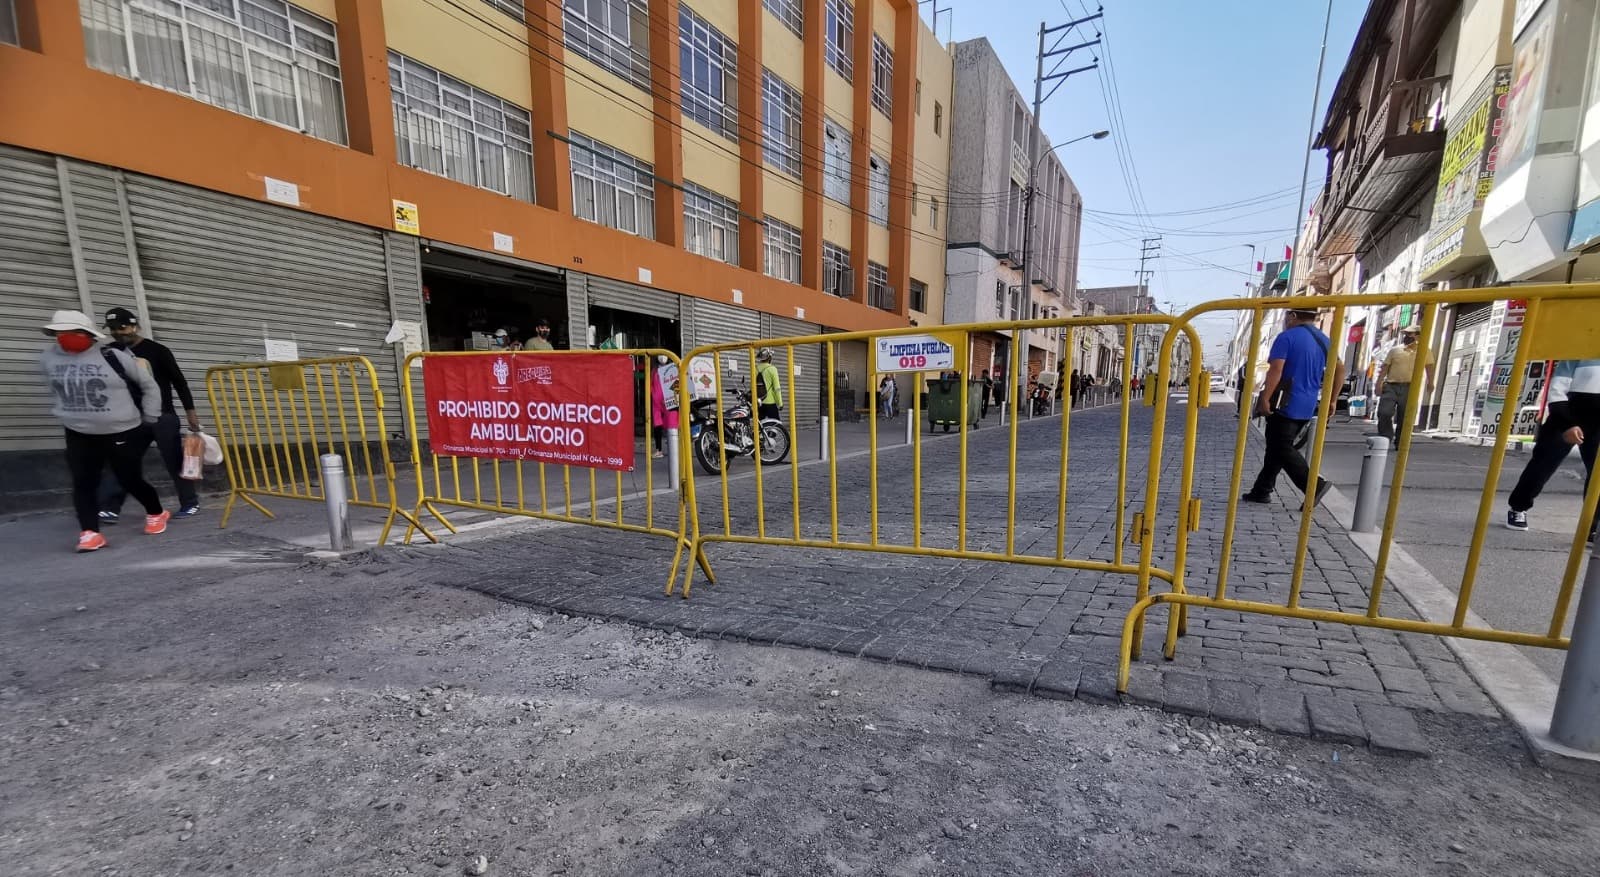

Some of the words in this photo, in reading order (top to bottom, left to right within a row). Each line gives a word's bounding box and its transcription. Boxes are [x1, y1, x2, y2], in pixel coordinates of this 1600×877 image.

[889, 344, 920, 357] LIMPIEZA
[899, 355, 927, 368] 019
[439, 400, 520, 419] PROHIBIDO
[527, 402, 622, 425] COMERCIO
[470, 423, 585, 447] AMBULATORIO
[553, 451, 582, 461] Municipal
